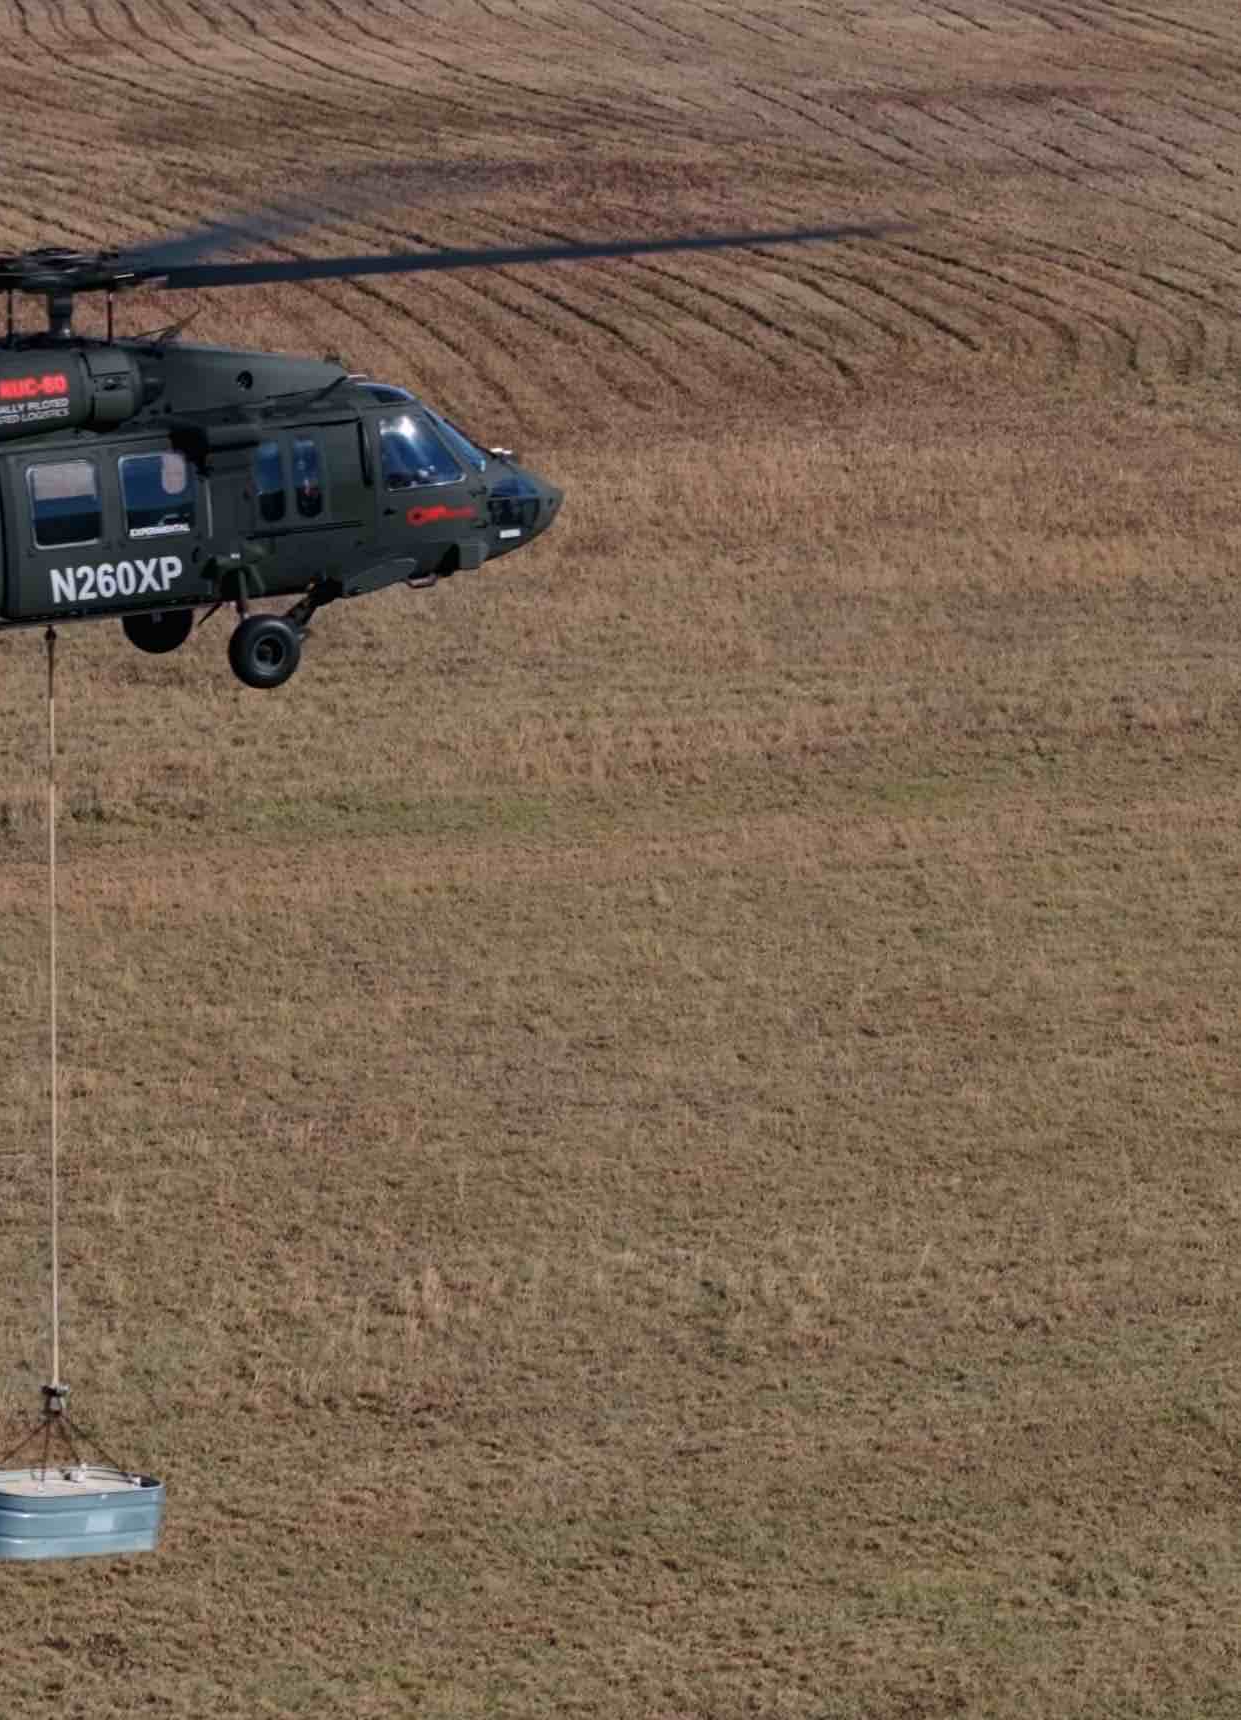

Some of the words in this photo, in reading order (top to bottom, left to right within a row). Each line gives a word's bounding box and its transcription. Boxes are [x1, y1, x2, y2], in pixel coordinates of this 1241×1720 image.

[27, 397, 70, 411] PILOTED
[21, 408, 70, 422] LOGISTICS
[49, 555, 183, 604] N260XP
